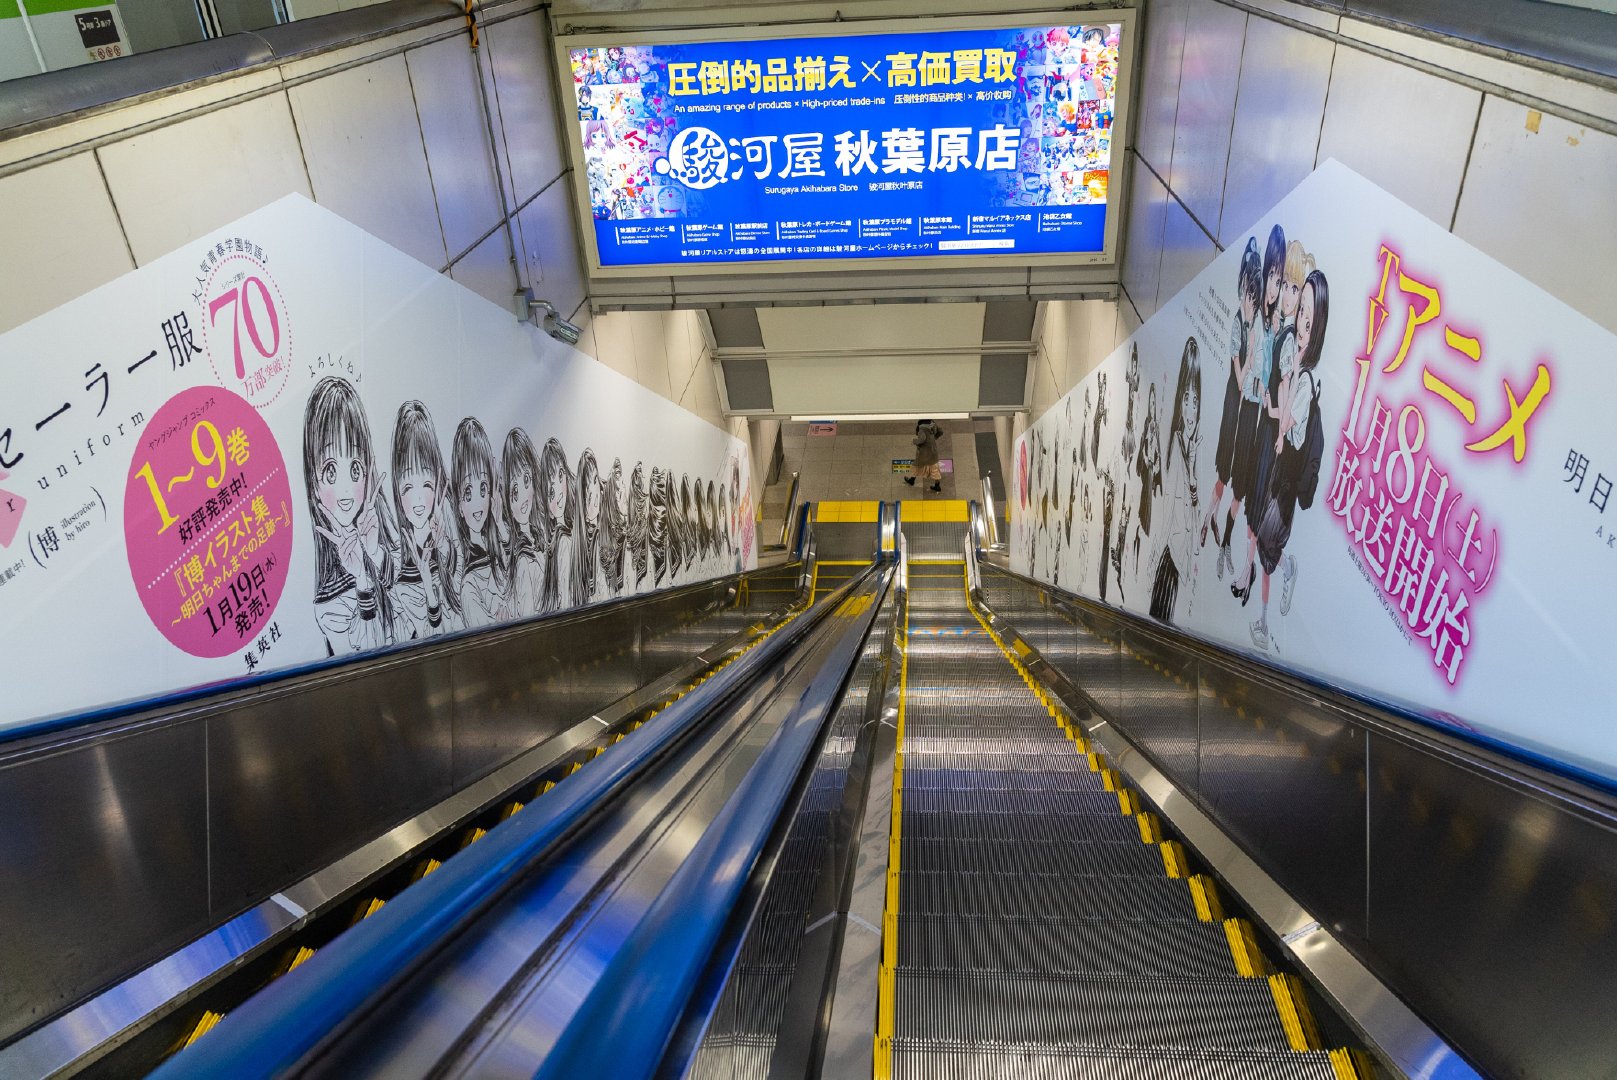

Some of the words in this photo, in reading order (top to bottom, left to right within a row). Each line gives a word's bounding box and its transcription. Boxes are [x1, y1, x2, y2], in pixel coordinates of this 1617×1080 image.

[674, 104, 686, 113] An
[687, 103, 721, 114] amazing
[723, 103, 746, 113] range
[748, 101, 756, 110] of
[757, 100, 792, 111] products
[801, 98, 848, 109] High-priced
[850, 96, 886, 106] trade-ins
[668, 126, 826, 190] 駿河屋
[834, 124, 1021, 177] 秋葉原店
[764, 186, 799, 195] Surugaya
[800, 184, 837, 193] Akihabara
[838, 183, 859, 192] Store
[208, 276, 280, 380] 70
[37, 411, 145, 490] uniform
[178, 471, 248, 545] 好評発売中!
[1562, 448, 1613, 514] 明日
[60, 500, 97, 530] illustration
[64, 530, 76, 542] by
[75, 519, 91, 534] hiro
[1327, 441, 1471, 685] 放送開始
[235, 588, 271, 639] 発売!
[243, 620, 283, 673] 集英社
